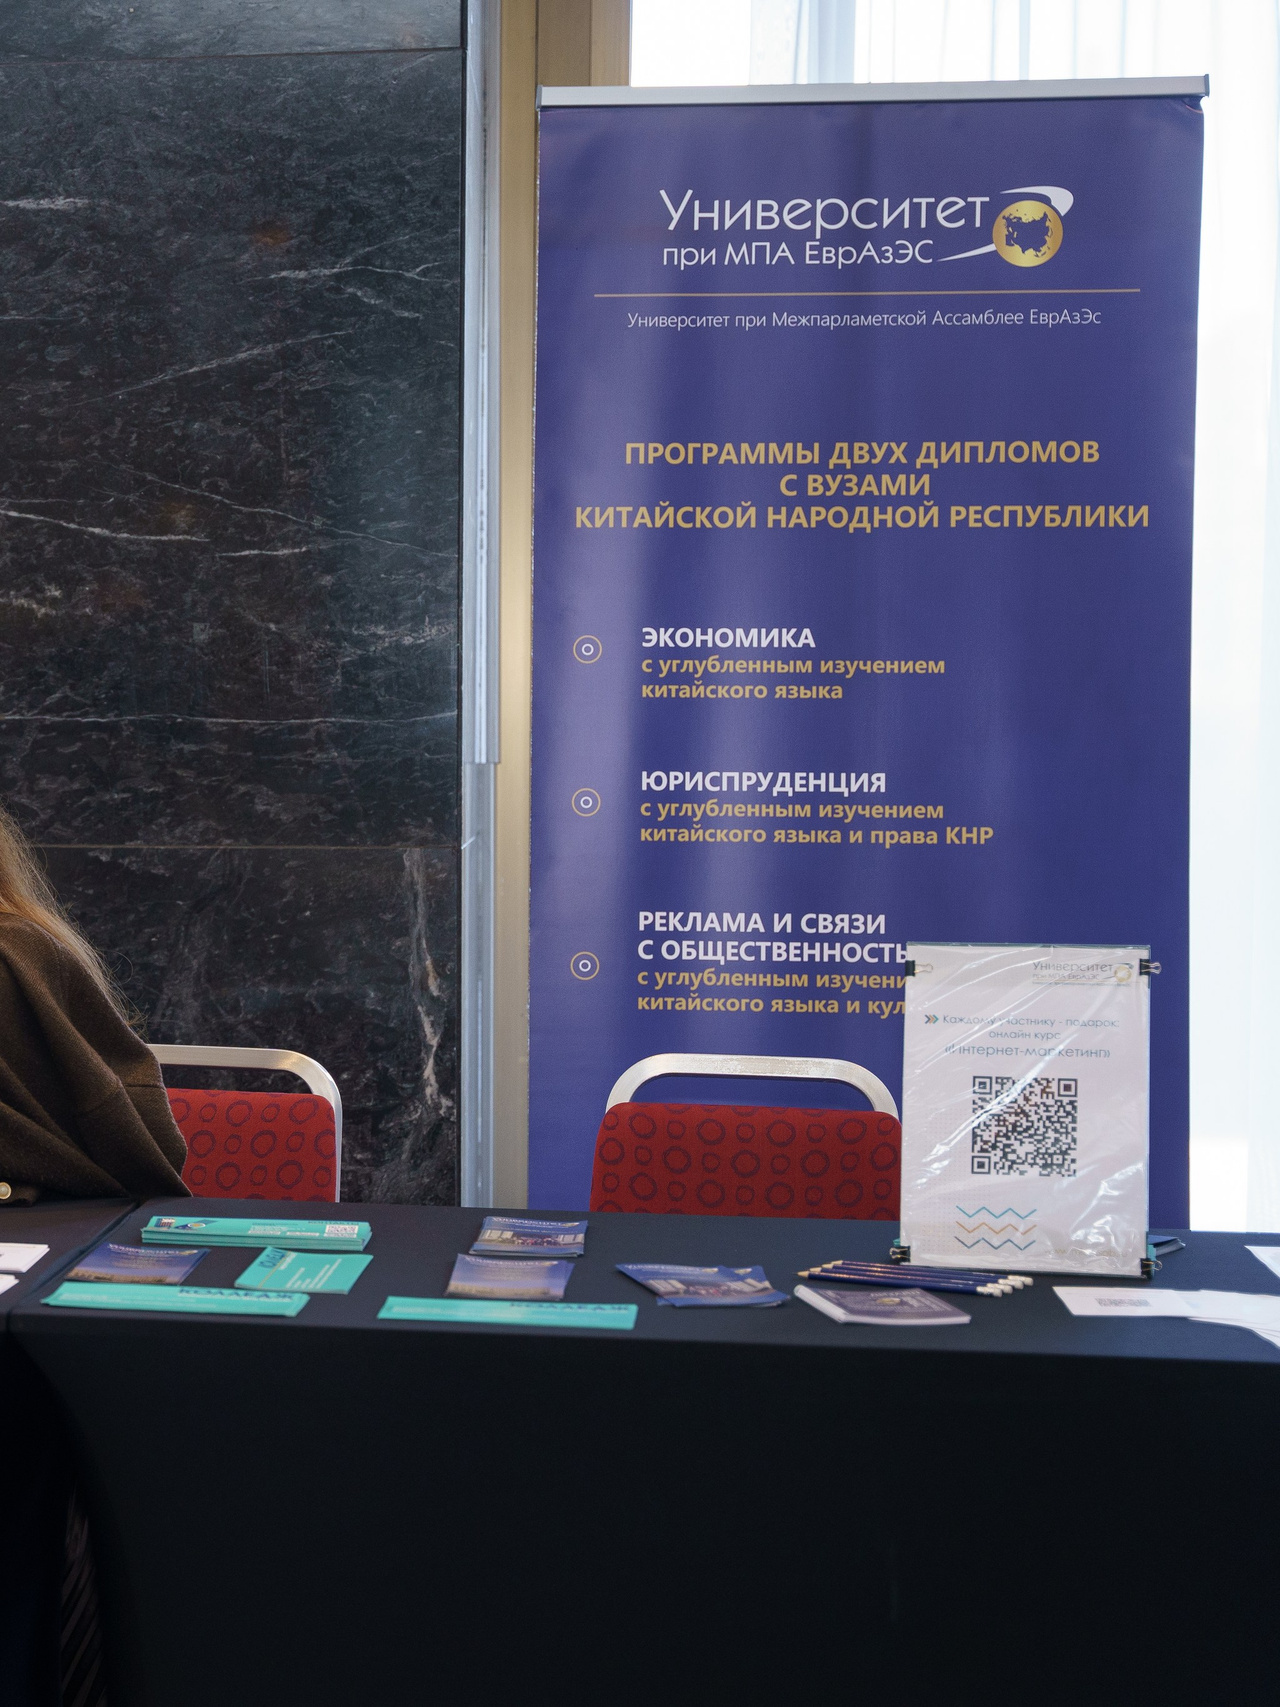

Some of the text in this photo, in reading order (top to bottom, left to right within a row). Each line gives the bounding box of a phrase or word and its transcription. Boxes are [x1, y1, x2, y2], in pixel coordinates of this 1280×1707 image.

[660, 189, 989, 239] Университет
[664, 240, 933, 270] при МПА ЕврАзЭС
[628, 313, 730, 331] Университет
[736, 316, 766, 331] при
[773, 310, 926, 330] Межпарламетской
[932, 309, 1024, 325] Ассамблее
[626, 441, 1099, 469] ПРОГРАММЫ ДВУХ ДИПЛОМОВ
[780, 474, 929, 496] С ВУЗАМИ
[576, 501, 1148, 533] КИТАЙСКОЙ НАРОДНОЙ РЕСПУБЛИКИ
[642, 628, 815, 648] ЭКОНОМИКА
[642, 655, 944, 678] с углубленным изучением
[642, 680, 842, 698] китайского языка
[642, 771, 885, 797] ЮРИСПРУДЕНЦИЯ
[641, 798, 943, 823] с углубленным изучением
[641, 824, 993, 849] китайского языка и права КНР
[639, 912, 885, 934] РЕКЛАМА И СВЯЗИ
[638, 940, 907, 966] С ОБЩЕСТВЕННОСТЬ
[1033, 962, 1113, 972] Университет
[638, 967, 906, 992] с углубленным изучени
[638, 993, 764, 1012] китайского
[771, 999, 838, 1013] языка
[847, 1000, 860, 1013] и
[989, 1030, 1061, 1042] онлайн курс
